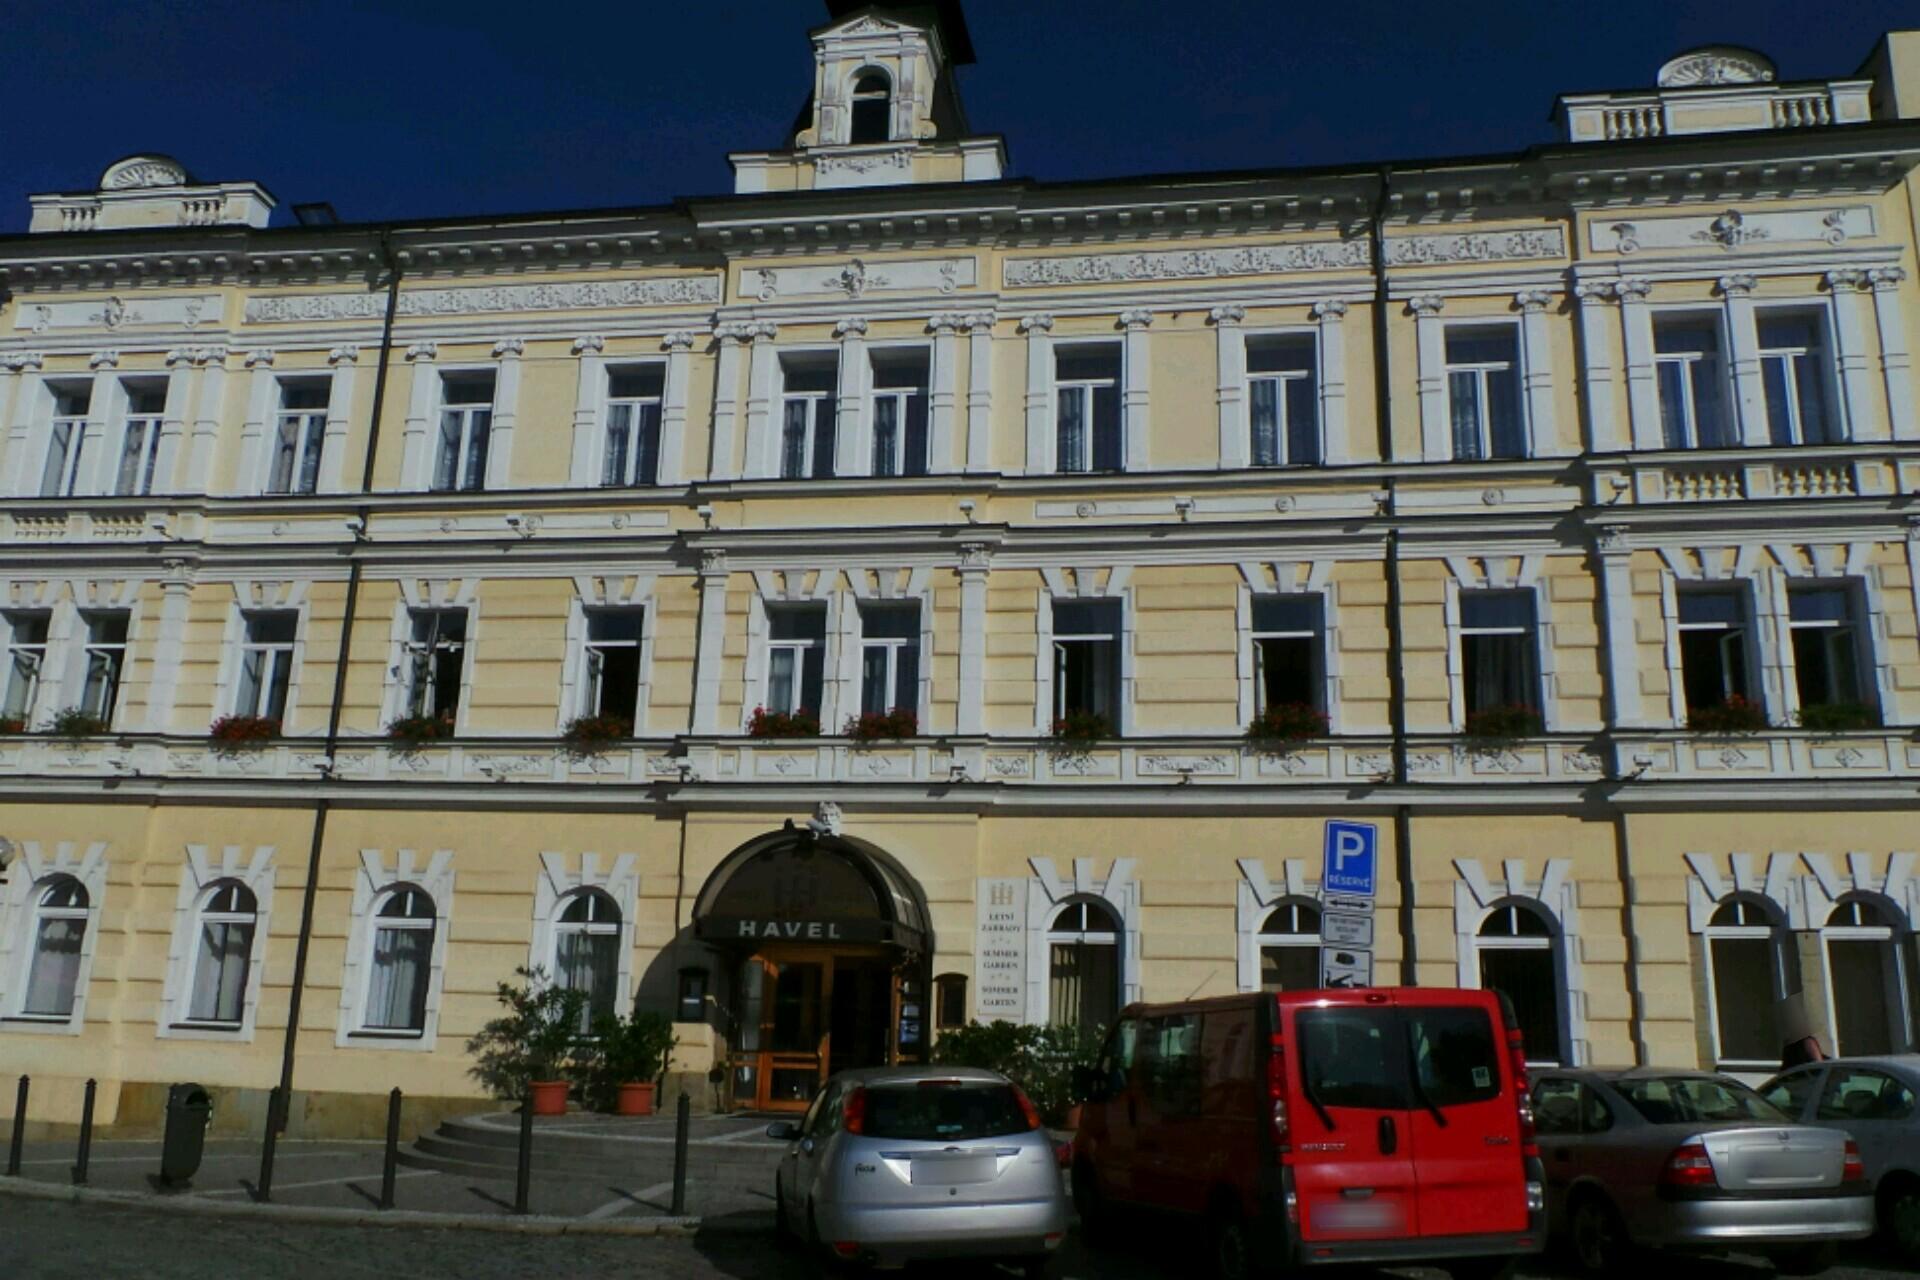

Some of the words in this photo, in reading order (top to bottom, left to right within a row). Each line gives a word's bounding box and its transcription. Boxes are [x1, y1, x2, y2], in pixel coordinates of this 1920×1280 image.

[1336, 831, 1365, 870] P
[739, 920, 841, 939] HAVEL
[983, 961, 1019, 969] GARDEN
